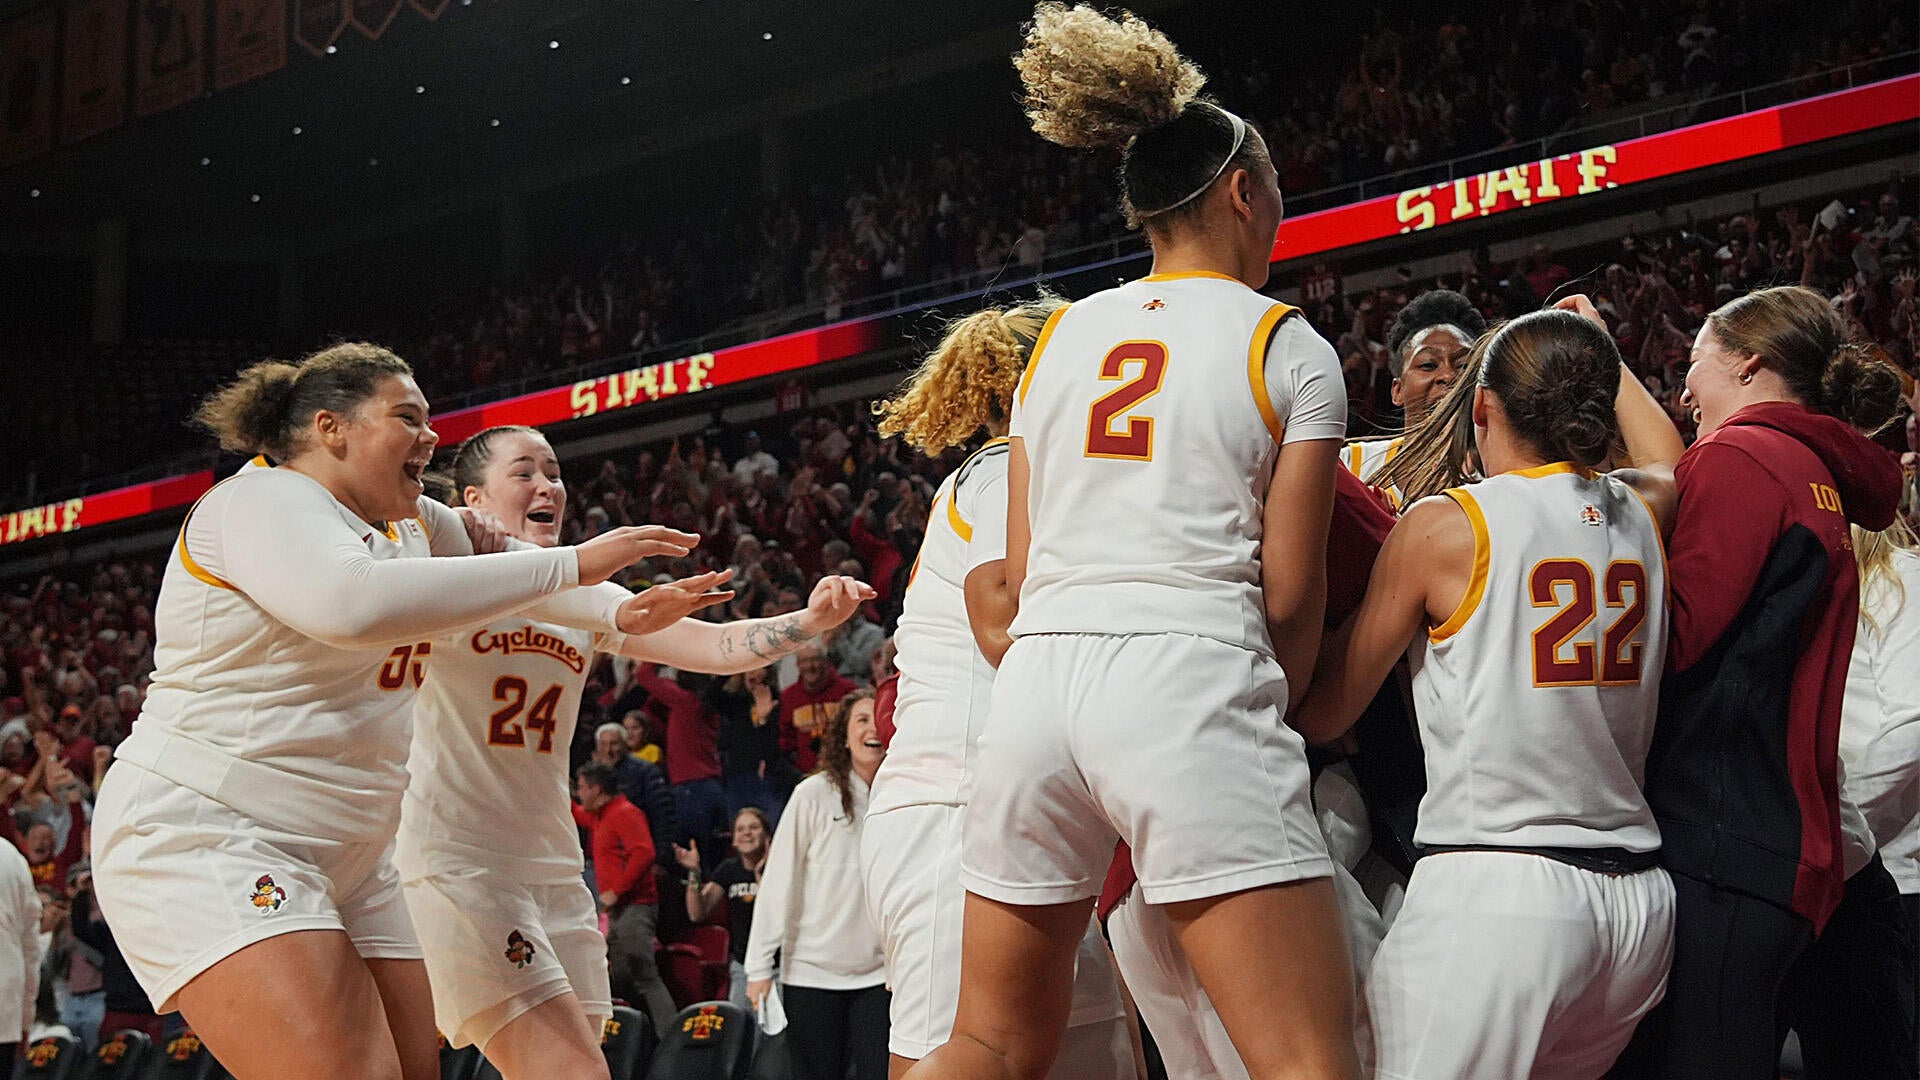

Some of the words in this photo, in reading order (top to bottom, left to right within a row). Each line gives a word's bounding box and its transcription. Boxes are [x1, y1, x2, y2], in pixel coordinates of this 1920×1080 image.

[1396, 145, 1617, 234] STATE
[570, 352, 715, 419] STATE
[1084, 339, 1170, 462] 2
[0, 497, 83, 543] TATE
[471, 624, 586, 673] Cyclones
[1528, 557, 1648, 688] 22
[487, 674, 564, 754] 24
